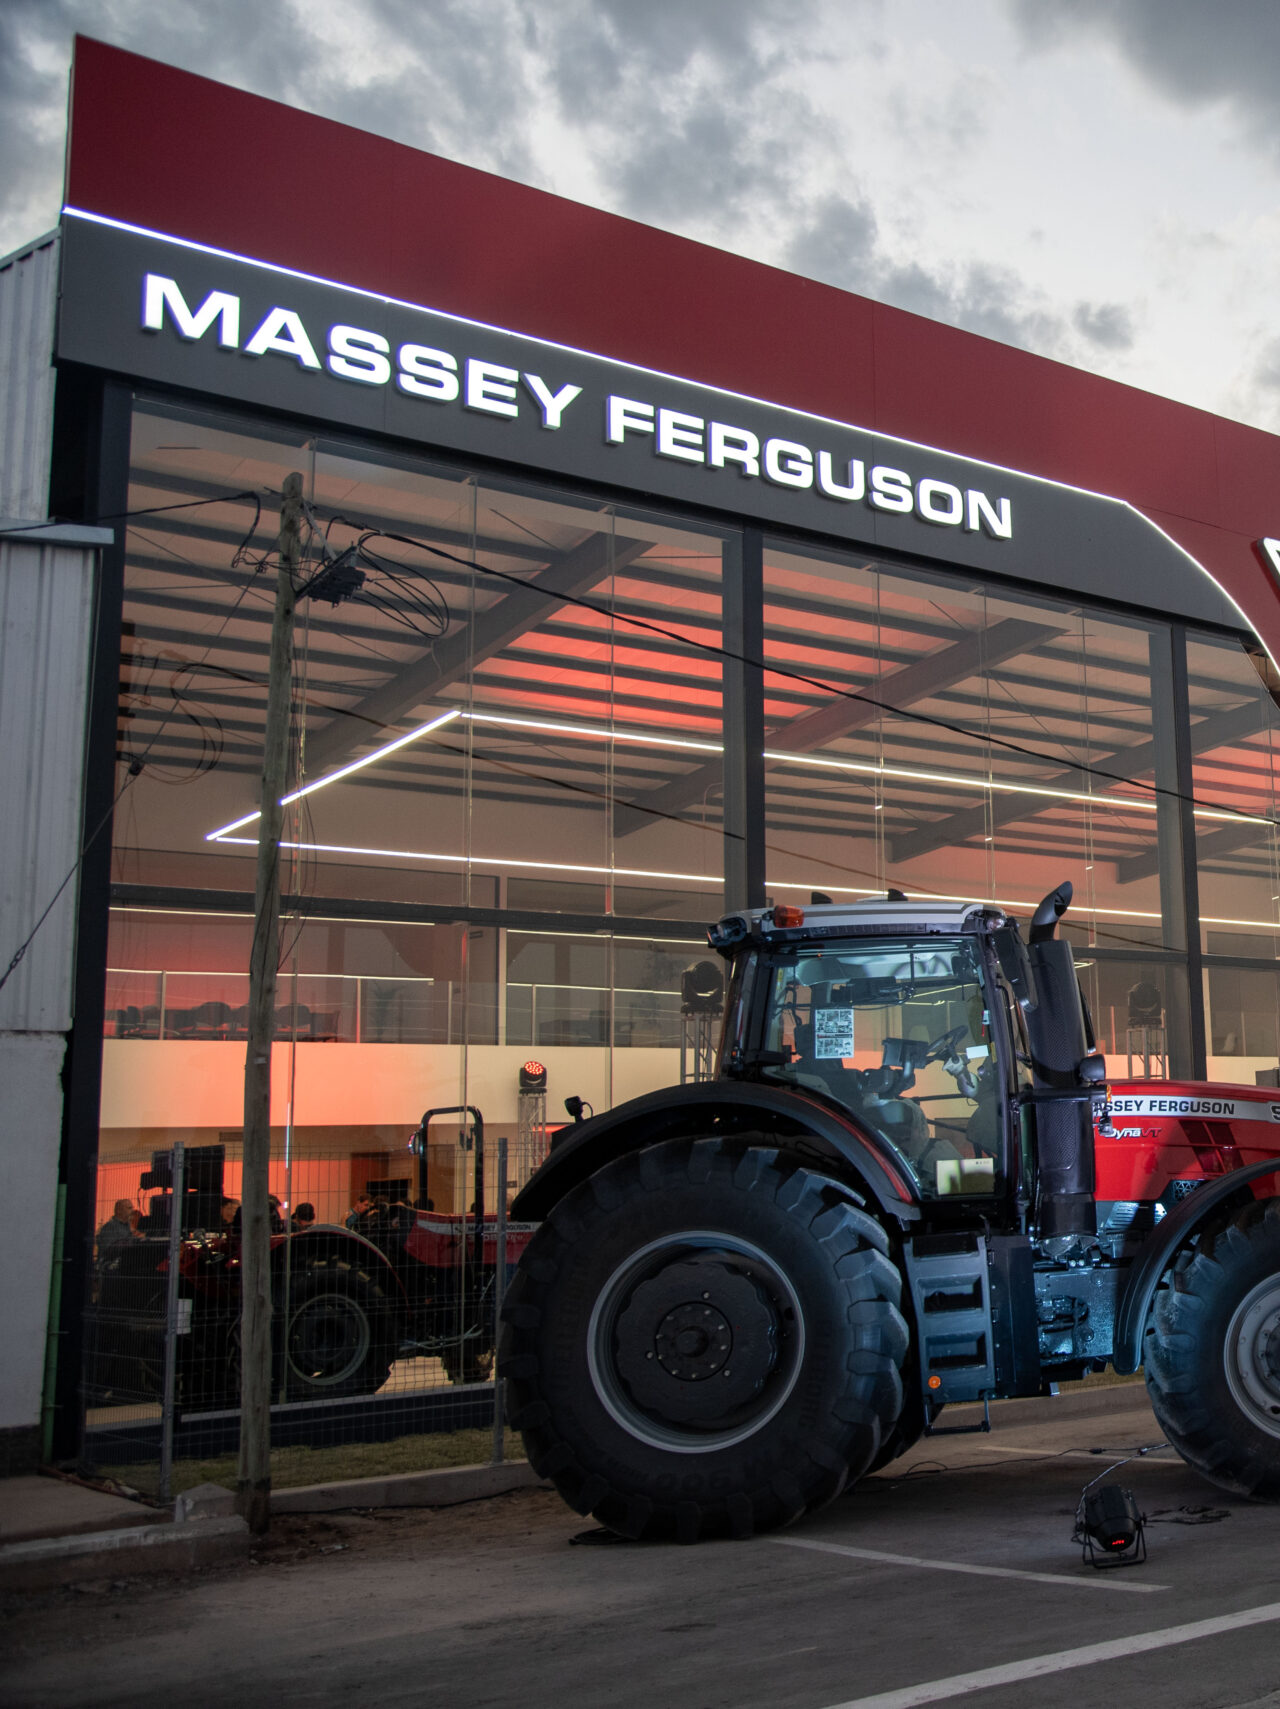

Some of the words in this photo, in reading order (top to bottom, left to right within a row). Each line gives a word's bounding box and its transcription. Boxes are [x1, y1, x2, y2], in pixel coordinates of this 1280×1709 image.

[142, 273, 583, 431] MASSEY
[606, 395, 1012, 540] FERGUSON
[1093, 1100, 1144, 1112] ASSEY
[1149, 1100, 1235, 1115] FERGUSON
